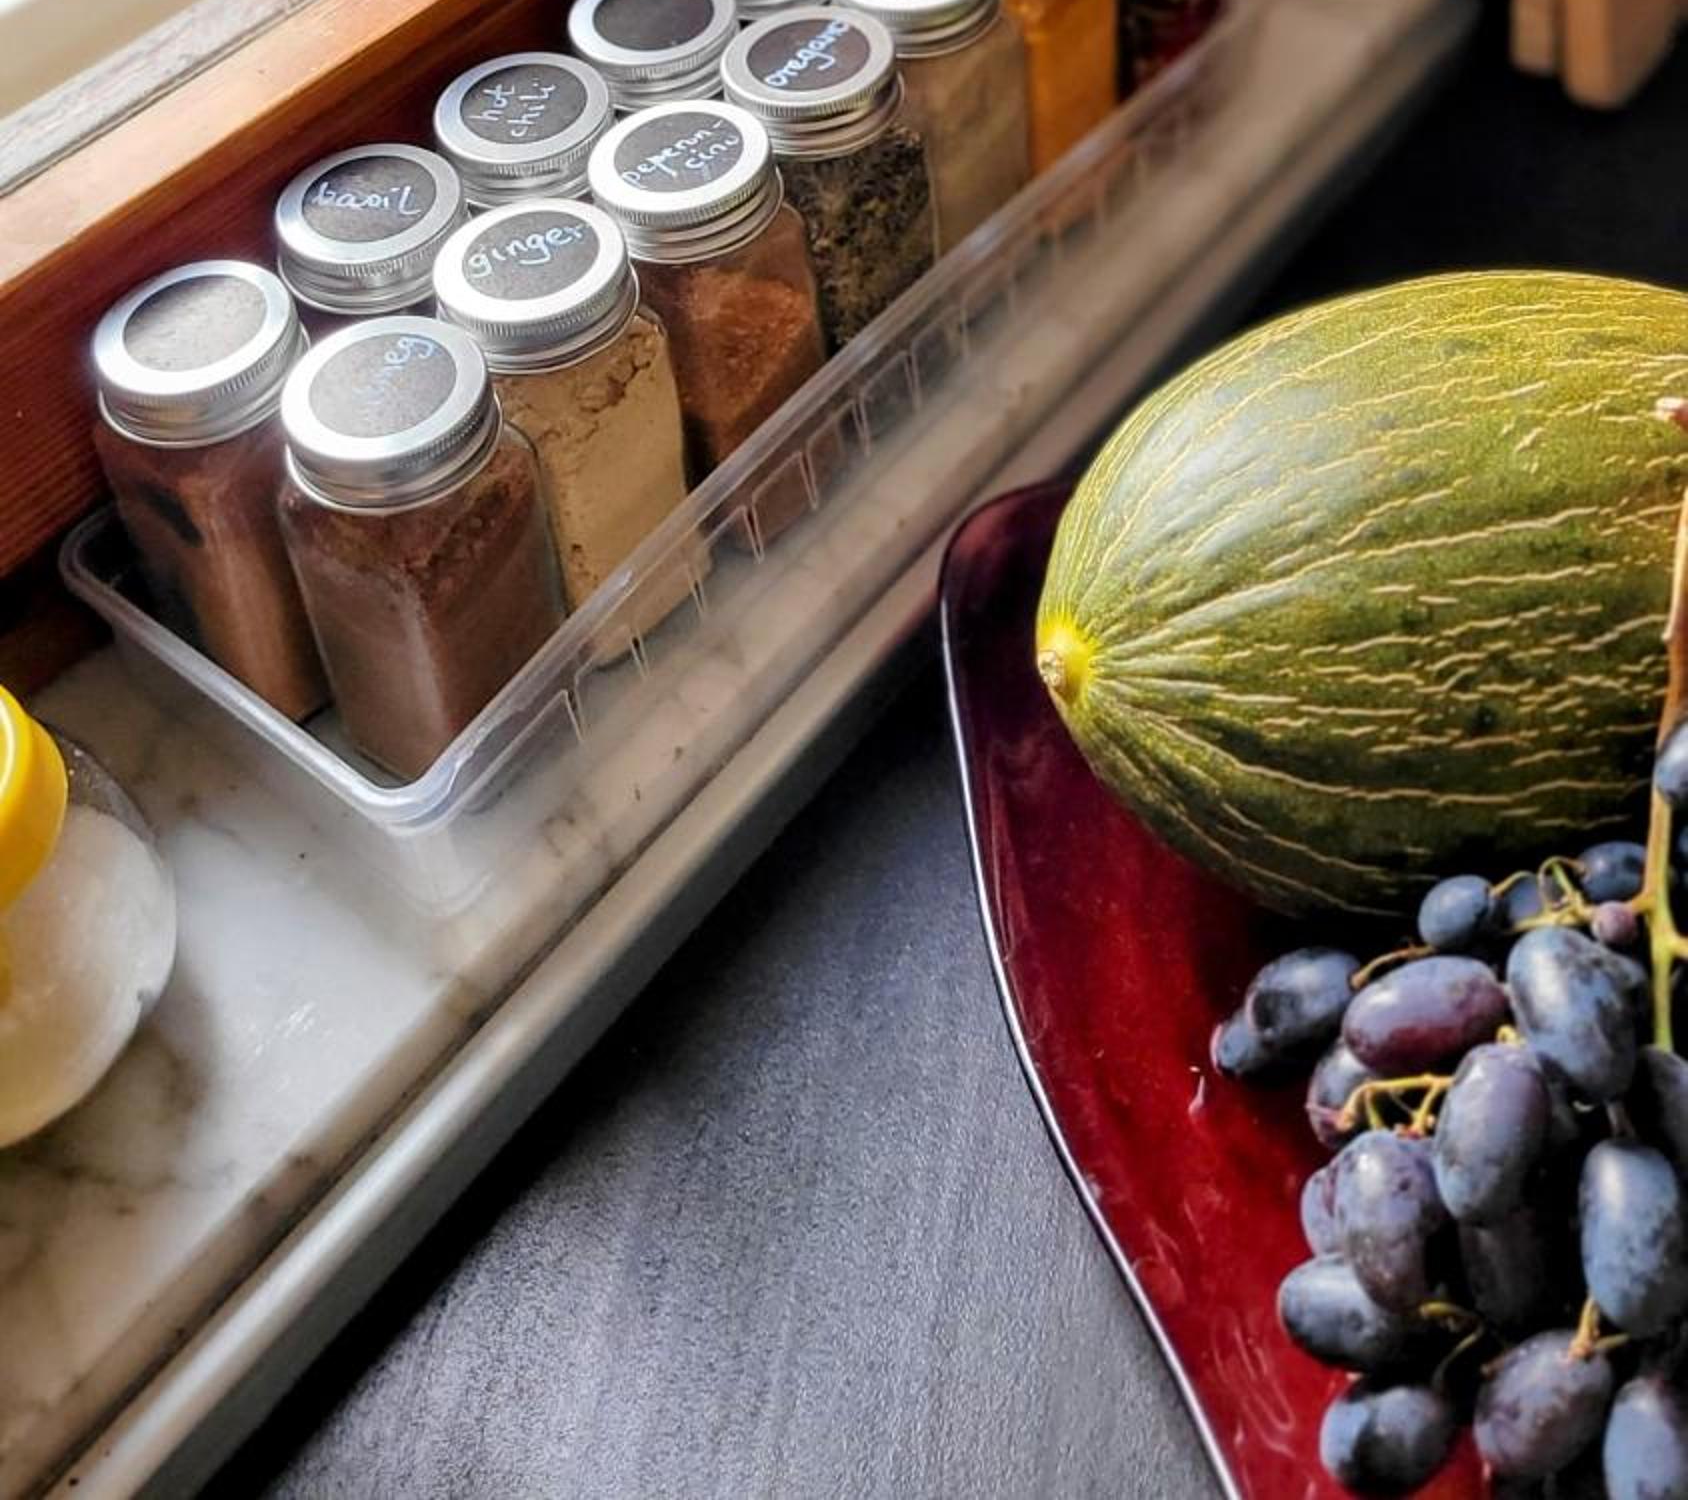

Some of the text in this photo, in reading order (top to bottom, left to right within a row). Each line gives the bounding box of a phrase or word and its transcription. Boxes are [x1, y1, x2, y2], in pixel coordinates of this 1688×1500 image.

[764, 18, 849, 87] oregano
[468, 83, 515, 121] hot
[507, 81, 557, 137] chili
[685, 134, 740, 169] cino
[311, 181, 422, 215] basil
[467, 222, 591, 279] ginger
